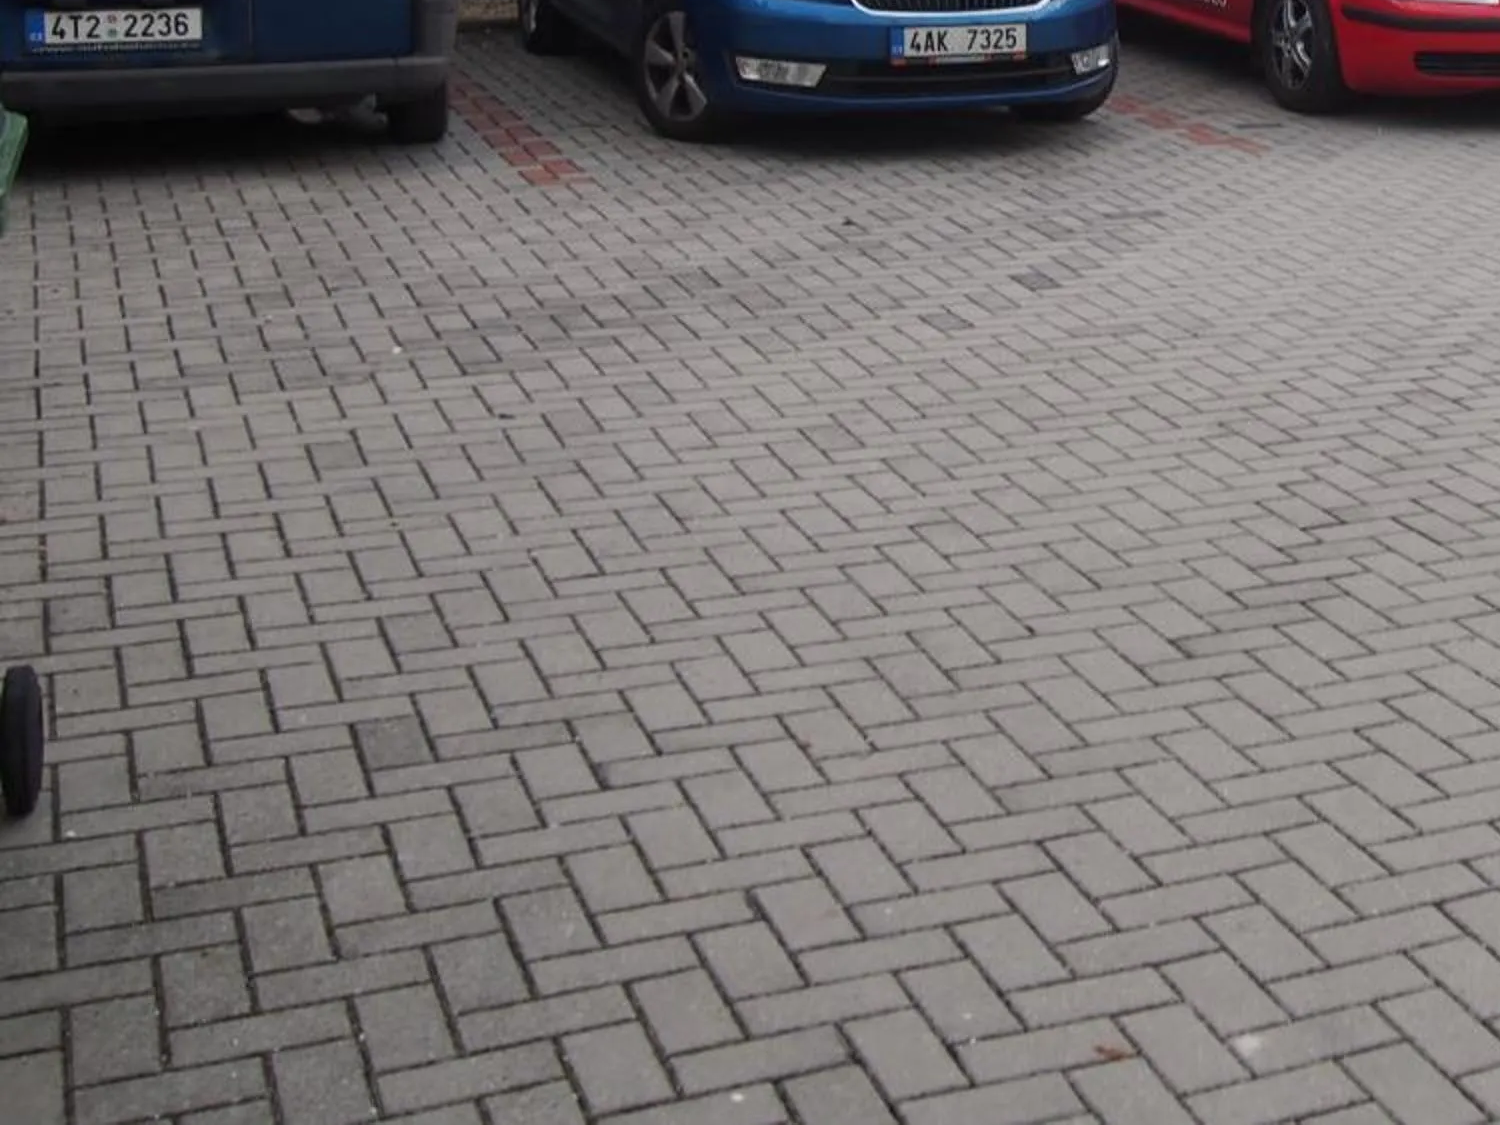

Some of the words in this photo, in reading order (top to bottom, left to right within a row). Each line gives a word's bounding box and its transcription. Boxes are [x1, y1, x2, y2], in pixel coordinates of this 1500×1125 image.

[51, 13, 100, 39] 4T2
[123, 12, 189, 38] 2236
[909, 29, 949, 52] 4AK
[966, 27, 1018, 51] 7325
